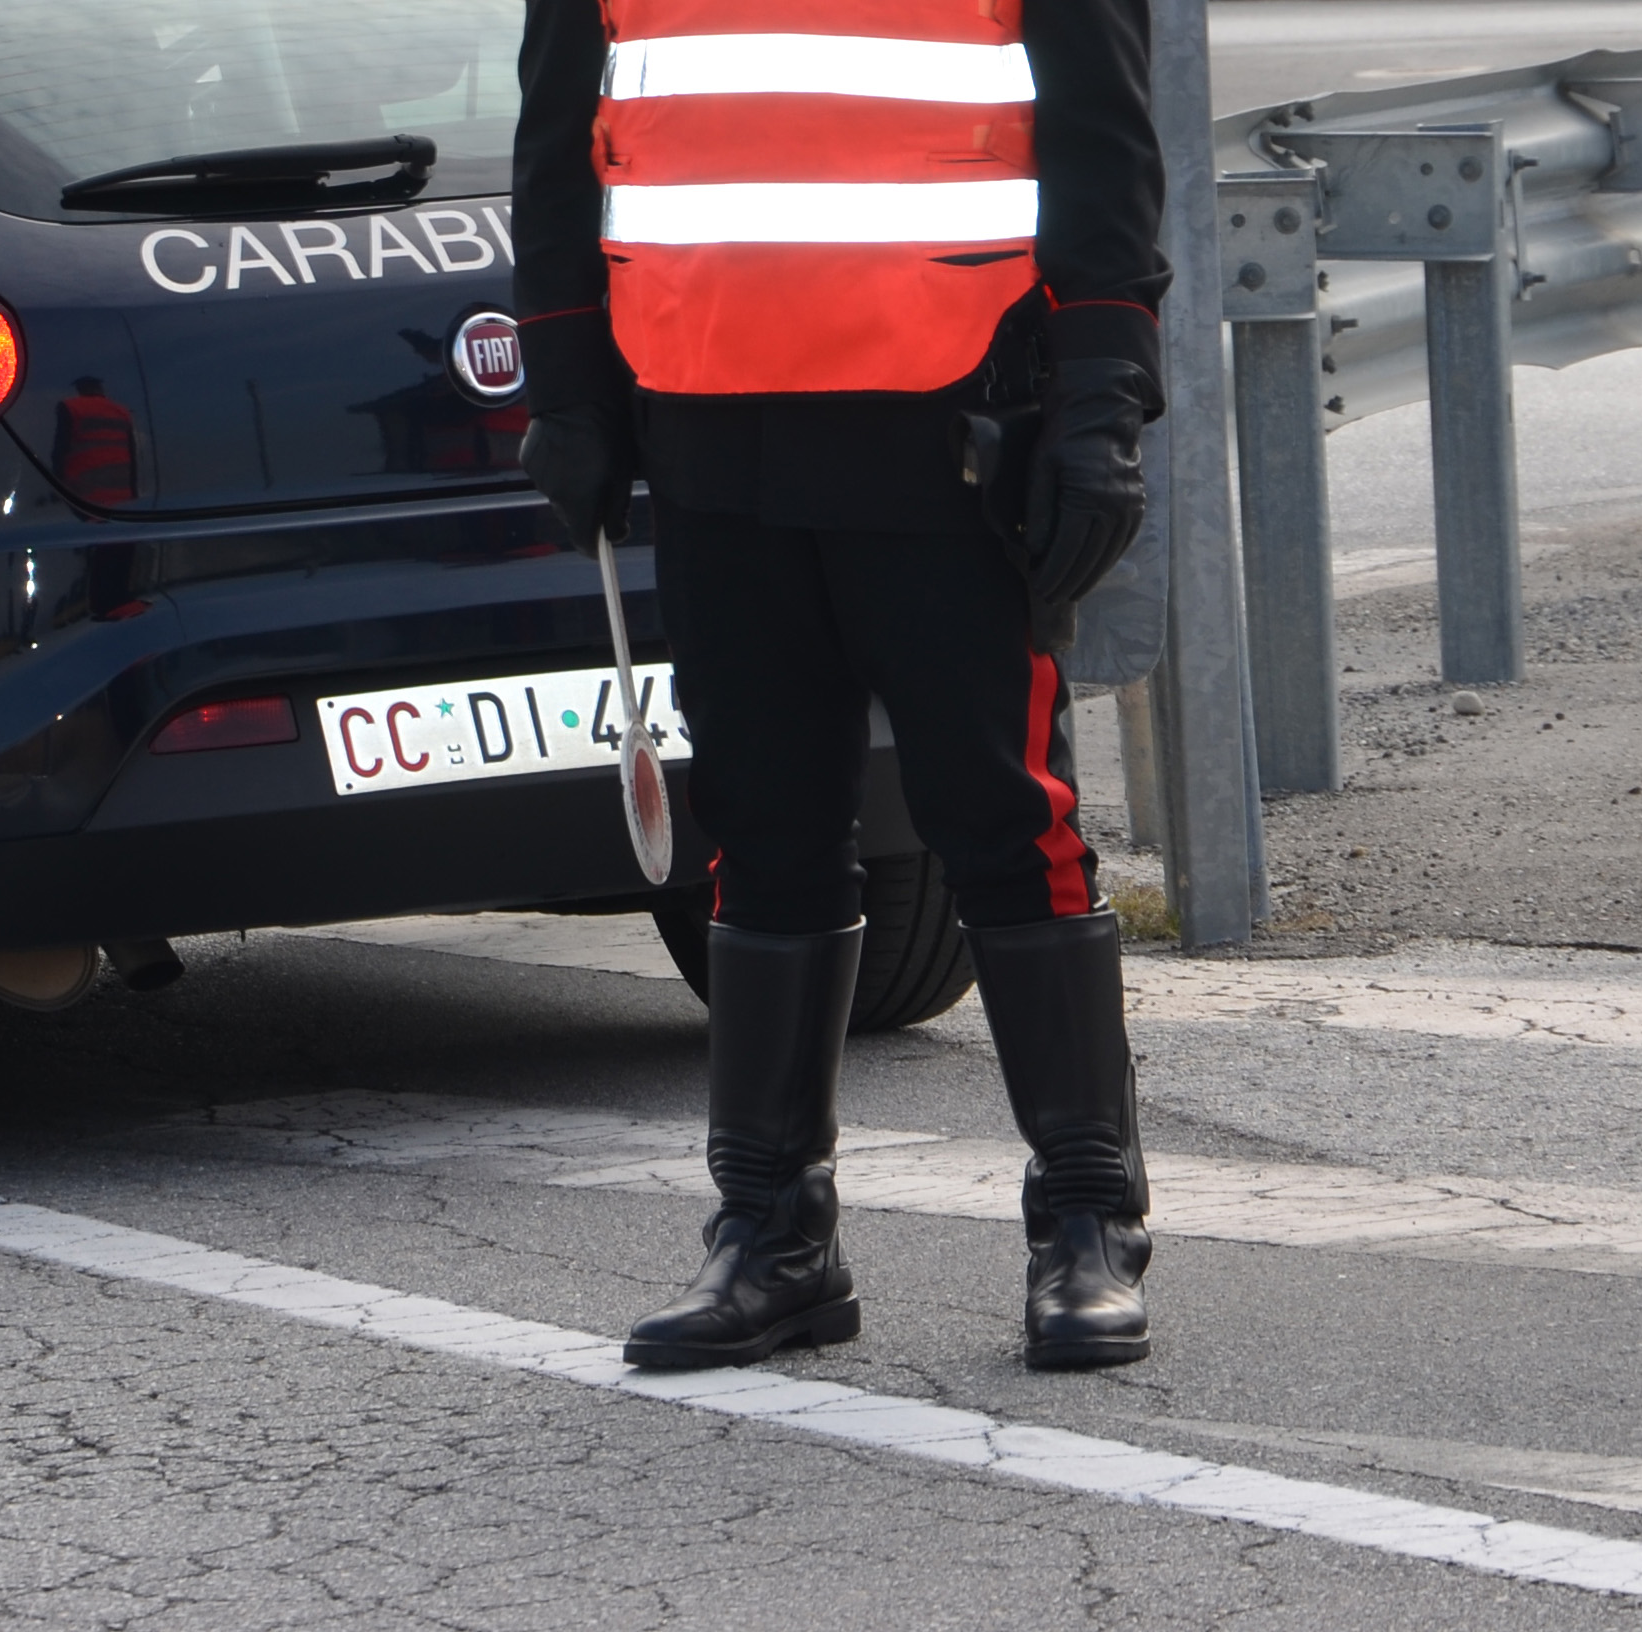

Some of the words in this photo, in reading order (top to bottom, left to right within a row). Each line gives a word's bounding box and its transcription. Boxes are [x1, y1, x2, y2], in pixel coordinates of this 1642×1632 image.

[139, 204, 516, 294] CARABI
[471, 336, 515, 375] FIAT
[339, 701, 430, 779] CC
[467, 686, 549, 764] DI
